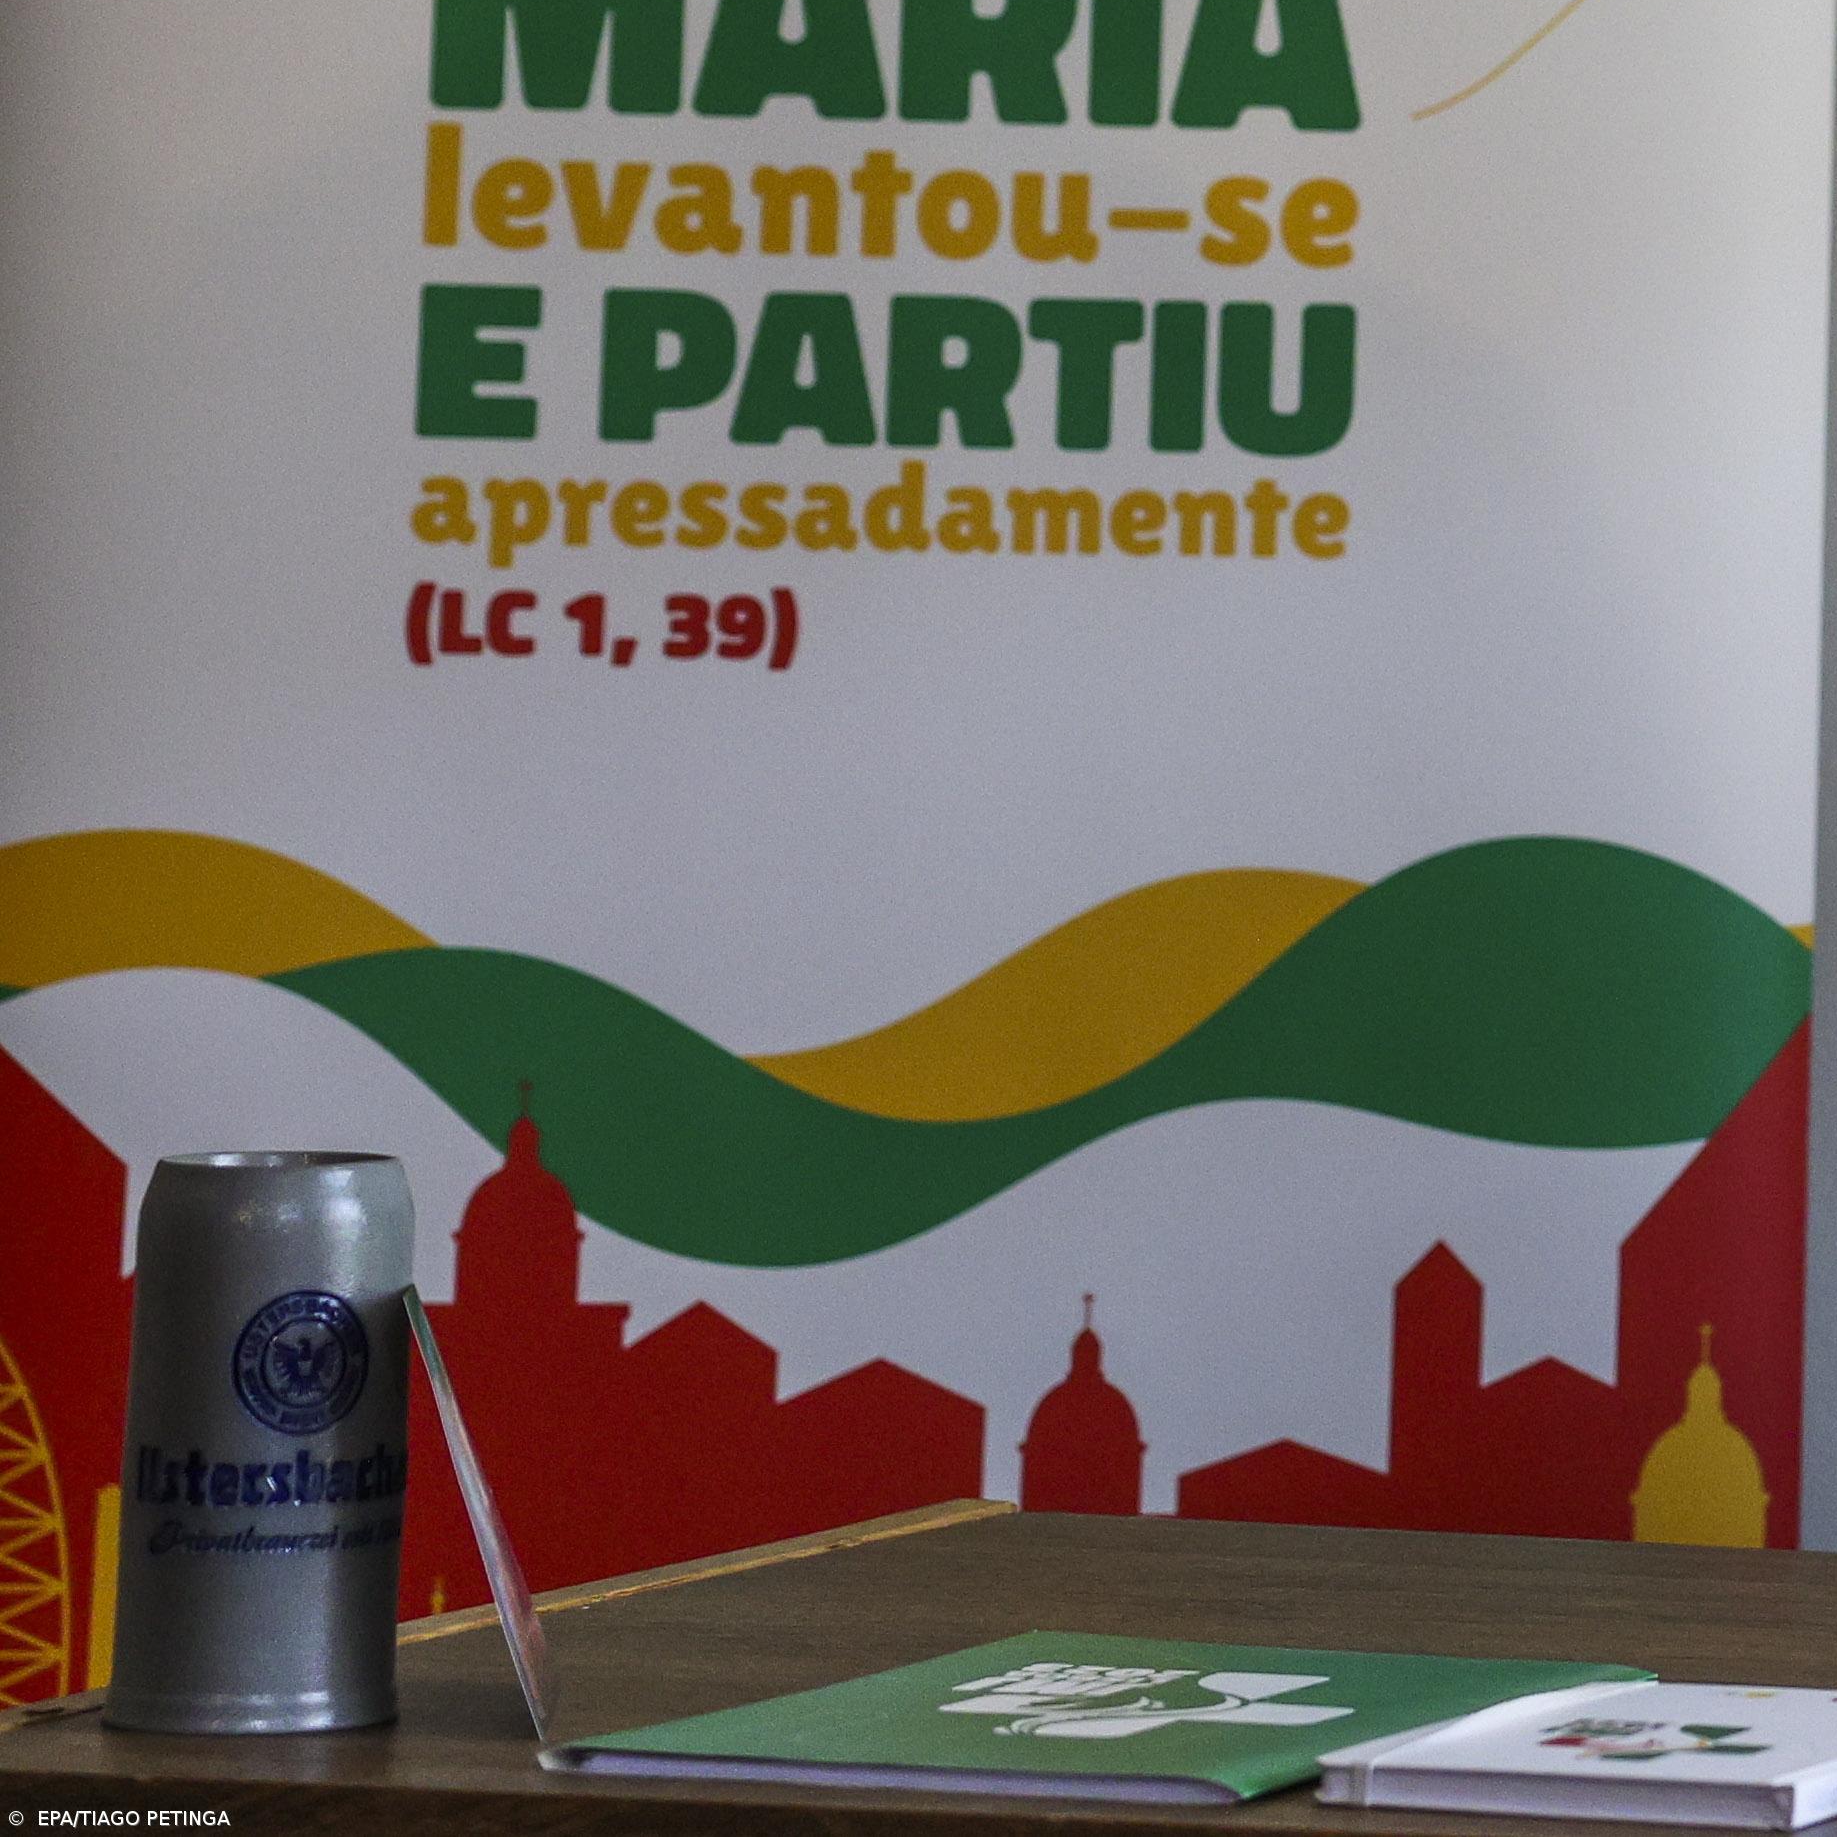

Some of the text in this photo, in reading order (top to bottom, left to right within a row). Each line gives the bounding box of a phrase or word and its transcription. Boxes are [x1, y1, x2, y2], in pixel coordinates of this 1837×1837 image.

[413, 282, 1359, 457] E PARTIU
[409, 458, 1352, 569] apressadamente
[406, 582, 799, 671] (LC 1, 39)
